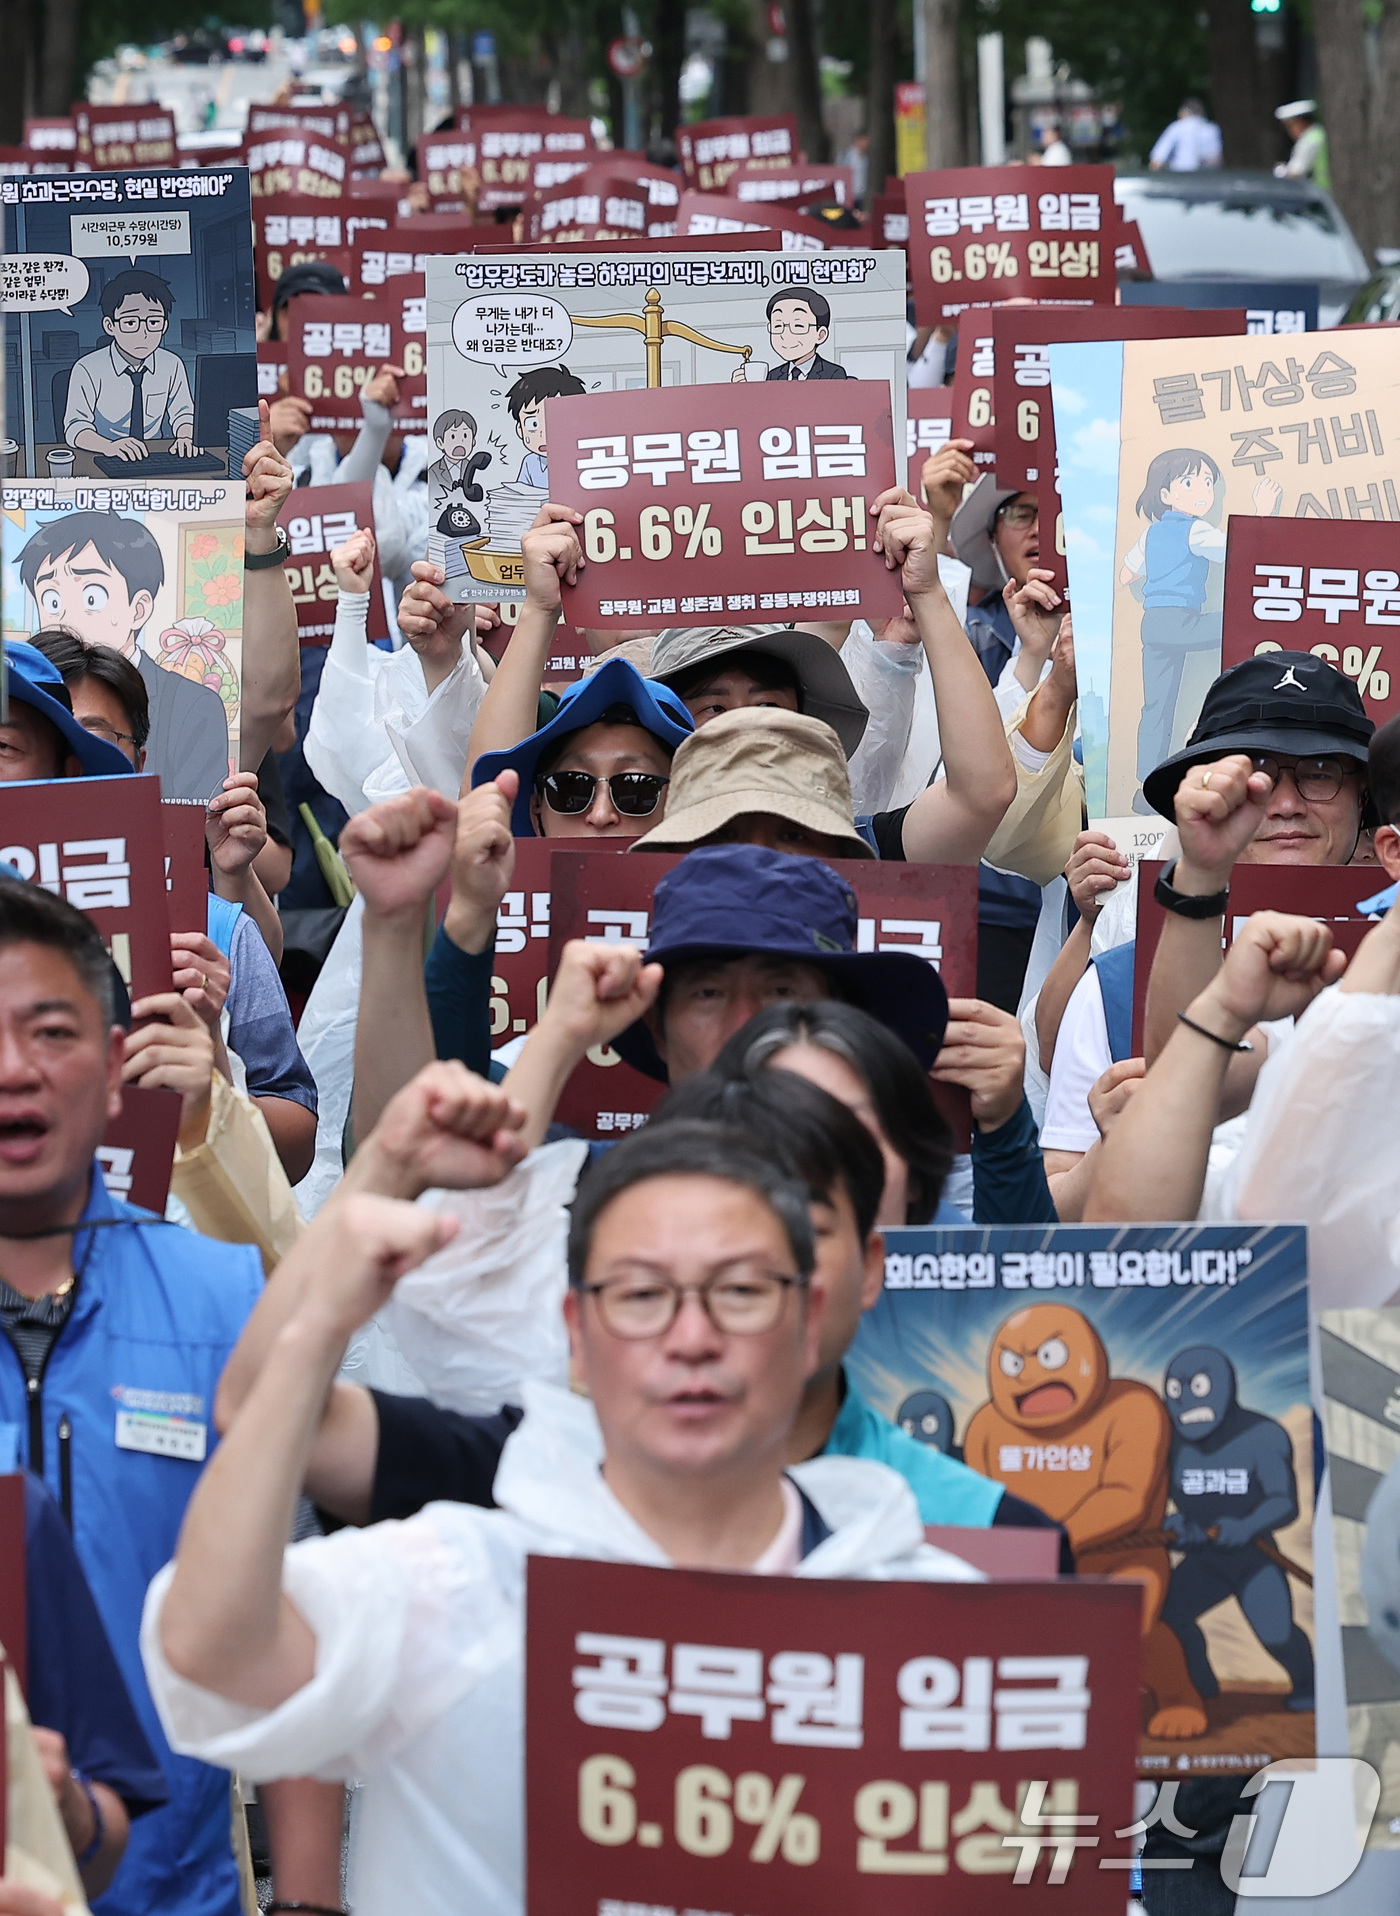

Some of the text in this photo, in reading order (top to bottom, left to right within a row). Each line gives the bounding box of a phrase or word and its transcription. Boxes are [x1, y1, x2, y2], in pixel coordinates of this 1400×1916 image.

[0, 181, 19, 204] 원
[22, 179, 123, 203] 초과근무수당,
[125, 177, 157, 200] 현실
[81, 219, 182, 233] 시간외근무 수당(시간당)
[925, 193, 1100, 236] 공무원 임금
[106, 234, 158, 248] 10,579원
[264, 215, 342, 246] 공무원
[43, 261, 68, 273] 환경,
[558, 262, 595, 287] 높은
[598, 262, 670, 286] 하위직의
[673, 260, 769, 287] 직급보조비,
[930, 241, 1018, 283] 6.6%
[1028, 241, 1099, 278] 인상!
[3, 275, 46, 288] 같은 업무!
[475, 306, 554, 321] 무게는 내가 더
[302, 322, 391, 357] 공무원
[466, 338, 563, 353] 왜 임금은 반대죠?
[1152, 350, 1357, 425] 물가상승
[576, 424, 867, 490] 공무원 임금
[1230, 409, 1385, 476] 주거비
[75, 488, 129, 511] 마음만
[583, 496, 867, 563] 6.6% 인상!
[600, 590, 861, 616] 공무원·교원 생존권 쟁취 공동투쟁위원회
[1252, 564, 1400, 626] 공무원
[1000, 1251, 1085, 1290] 균형이
[999, 1445, 1092, 1472] 물가인상
[1181, 1467, 1249, 1495] 공과금
[571, 1631, 1091, 1753] 공무원 임금
[577, 1753, 1080, 1876] 6.6% 인상!
